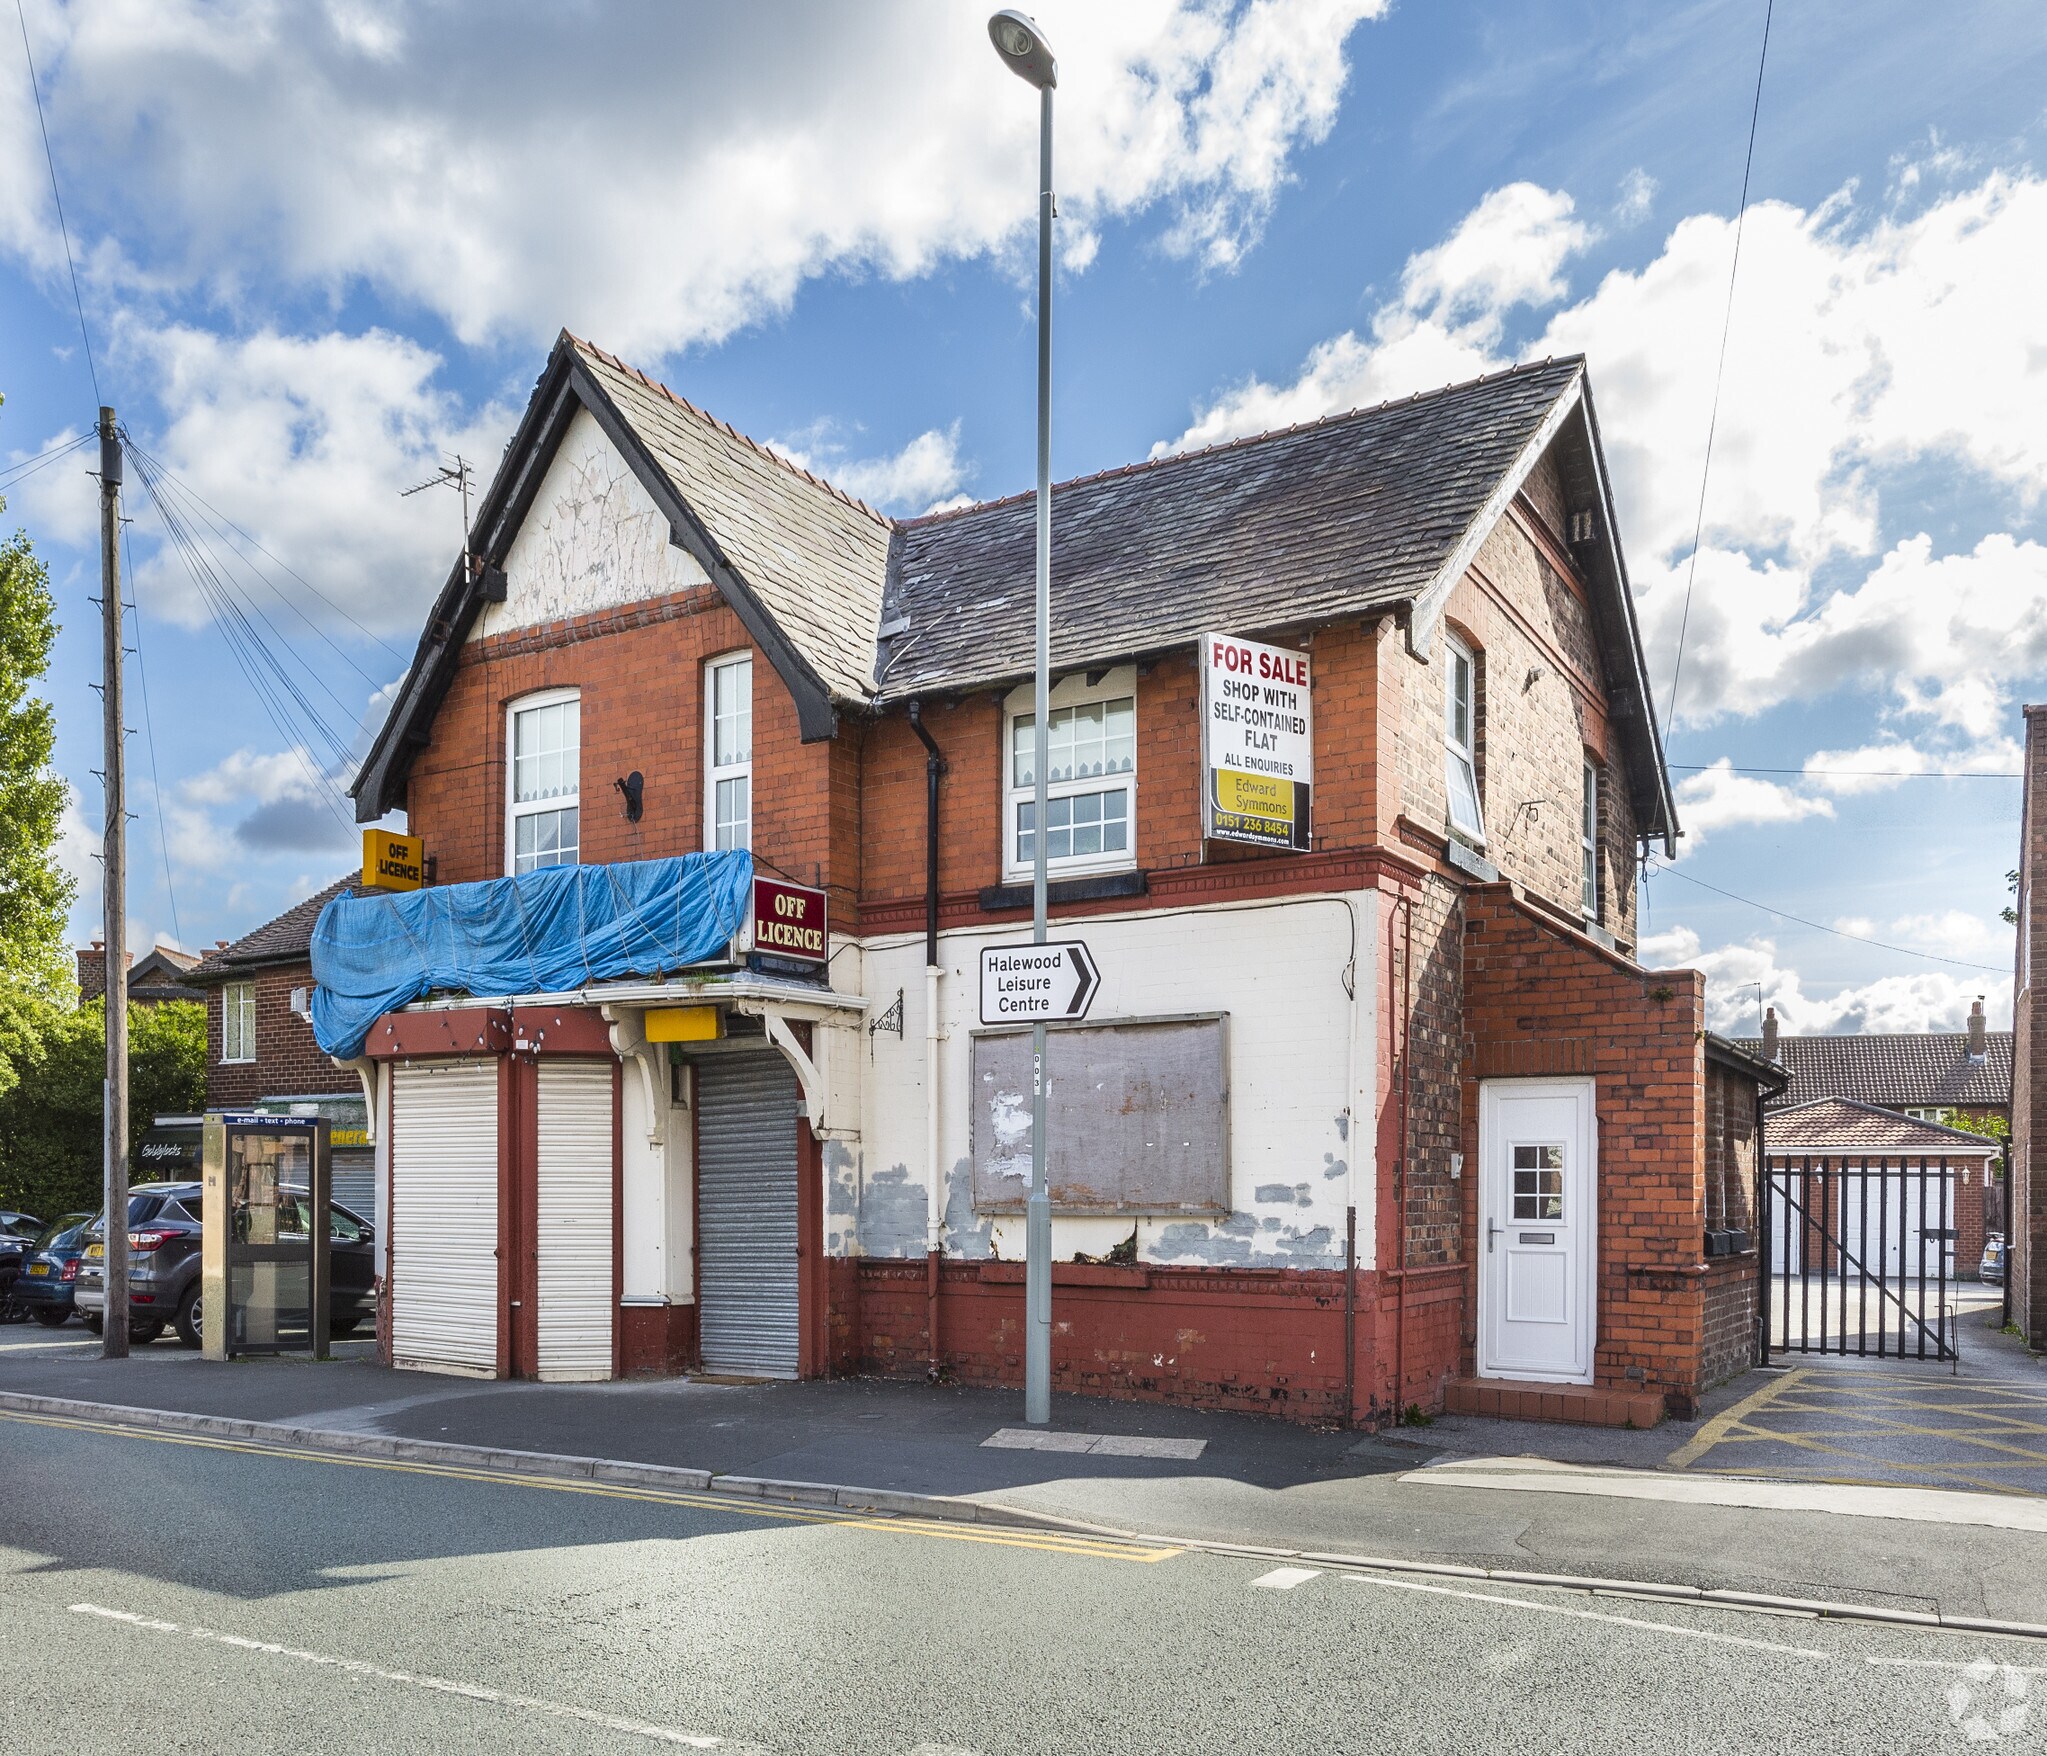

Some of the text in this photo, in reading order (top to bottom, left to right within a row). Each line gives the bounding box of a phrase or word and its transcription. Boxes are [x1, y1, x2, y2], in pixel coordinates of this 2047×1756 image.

[1213, 642, 1307, 687] FOR SALE
[1223, 679, 1297, 710] SHOP WITH
[1214, 701, 1305, 735] SELF-CONTAINED
[1245, 730, 1278, 752] FLAT
[1224, 753, 1294, 776] ALL ENQUIRIES
[1236, 778, 1276, 797] Edward
[1236, 795, 1287, 815] Symmons
[1216, 812, 1289, 836] 0151 236 8454
[1216, 828, 1290, 845] www.edwardsymmons.com
[388, 842, 409, 860] OFF
[379, 859, 419, 881] LICENCE
[774, 893, 806, 919] OFF
[757, 919, 822, 951] LICENCE
[988, 952, 1061, 972] Halewood
[998, 976, 1051, 992] Leisure
[998, 996, 1050, 1012] Centre
[236, 1116, 306, 1126] e-mail text phone
[329, 1129, 368, 1145] enera
